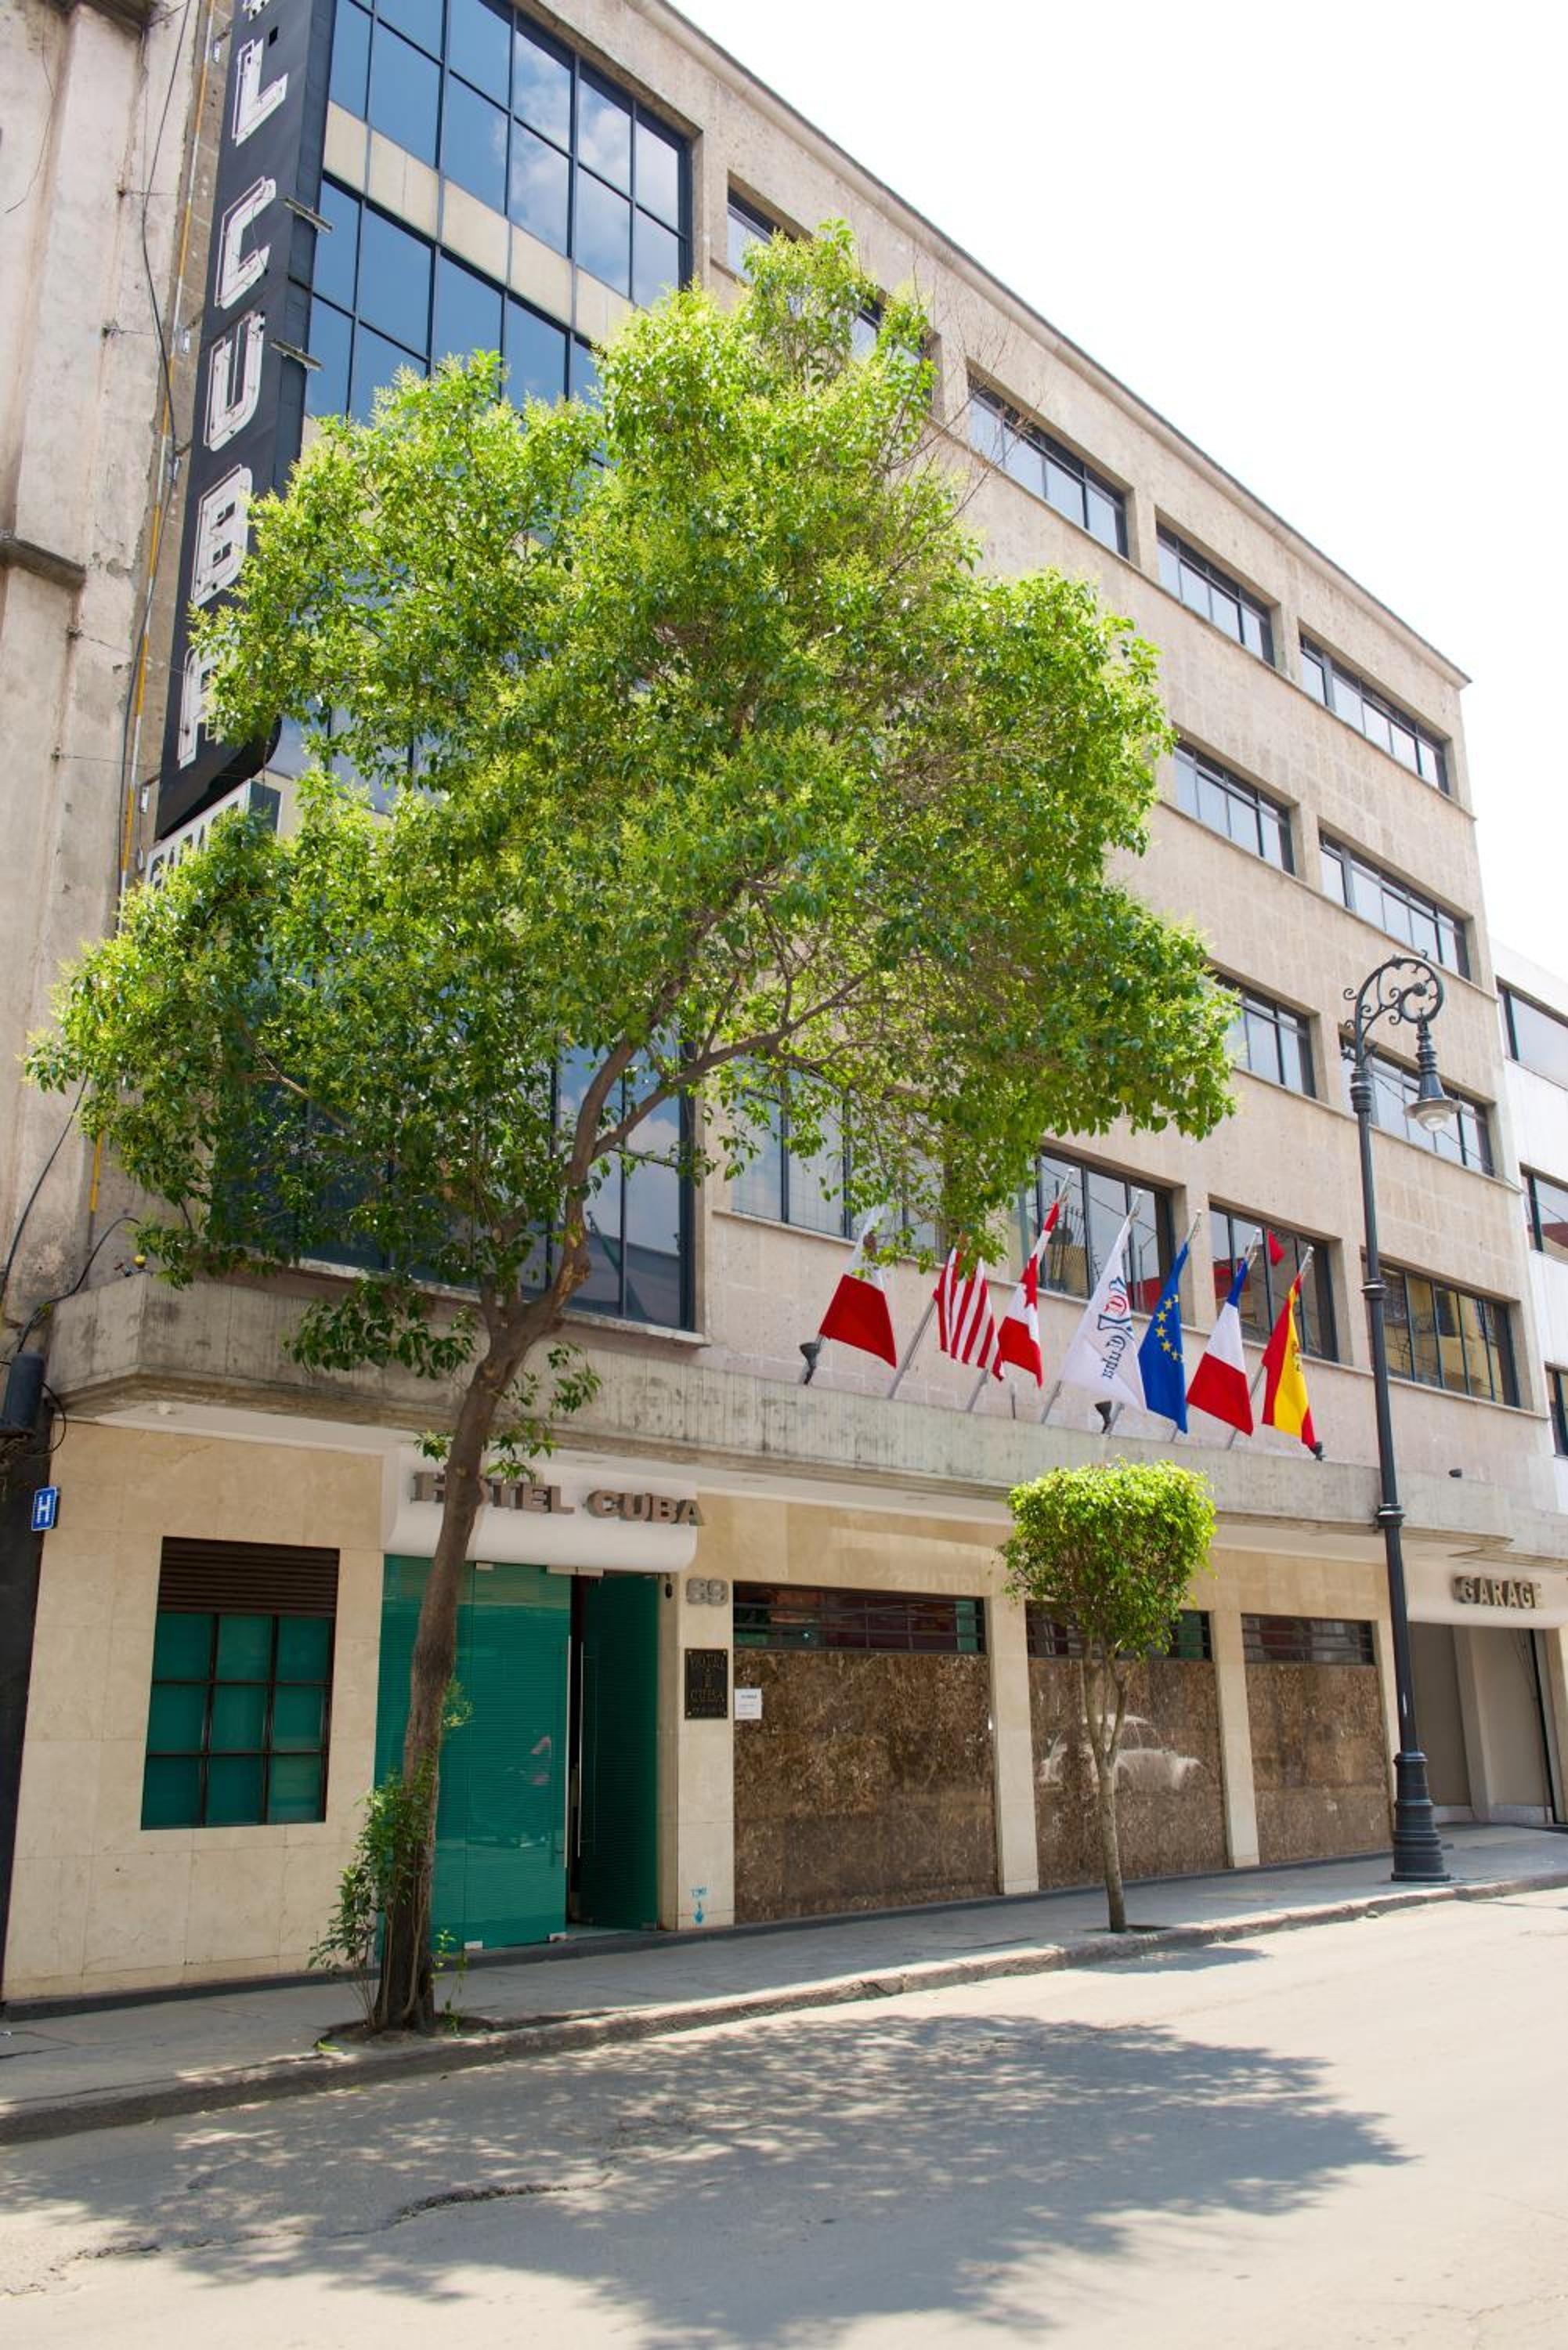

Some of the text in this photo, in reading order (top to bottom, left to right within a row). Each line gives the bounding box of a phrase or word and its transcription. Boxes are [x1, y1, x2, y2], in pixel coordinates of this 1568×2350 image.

[38, 1495, 51, 1523] H
[412, 1471, 704, 1527] HTEL CUBA
[1454, 1575, 1544, 1609] GARAGE
